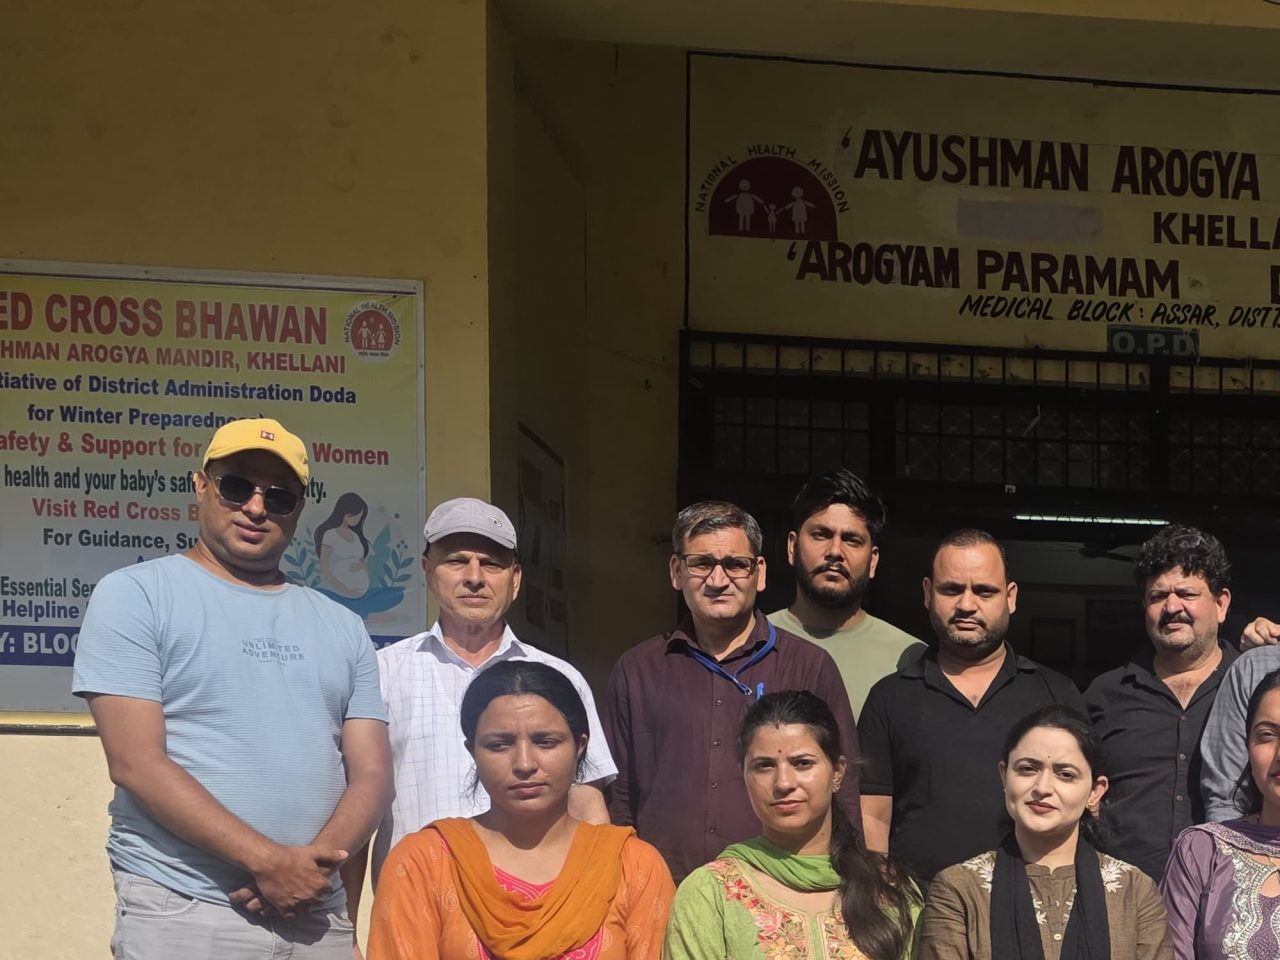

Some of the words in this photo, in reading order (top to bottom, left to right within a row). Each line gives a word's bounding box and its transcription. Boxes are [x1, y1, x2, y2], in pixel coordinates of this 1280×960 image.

[696, 155, 738, 213] NATIONAL
[748, 144, 796, 159] HEALTH
[808, 158, 850, 214] MISSION
[1111, 144, 1260, 201] AROGYA
[977, 248, 1180, 300] PARAMAM
[45, 294, 163, 338] CROSS
[175, 301, 328, 345] BHAWAN
[959, 294, 1054, 321] MEDICAL
[67, 343, 150, 365] AROGYA
[156, 347, 240, 372] MANDIR,
[247, 352, 346, 374] KHELLANI
[63, 374, 83, 393] of
[89, 376, 159, 396] District
[164, 379, 303, 402] Administration
[309, 386, 357, 404] Doda
[27, 405, 55, 422] for
[60, 406, 123, 425] Winter
[57, 432, 74, 454] &
[81, 433, 165, 461] Support
[173, 436, 200, 457] for
[313, 442, 388, 466] Women
[5, 464, 49, 488] health
[54, 467, 80, 489] and
[85, 473, 116, 494] your
[120, 469, 165, 498] baby's
[32, 498, 77, 518] Visit
[83, 500, 120, 520] Red
[126, 501, 181, 522] Cross
[43, 527, 72, 546] For
[79, 529, 170, 553] Guidance,
[1, 575, 67, 598] Essential
[3, 599, 80, 622] Helpline
